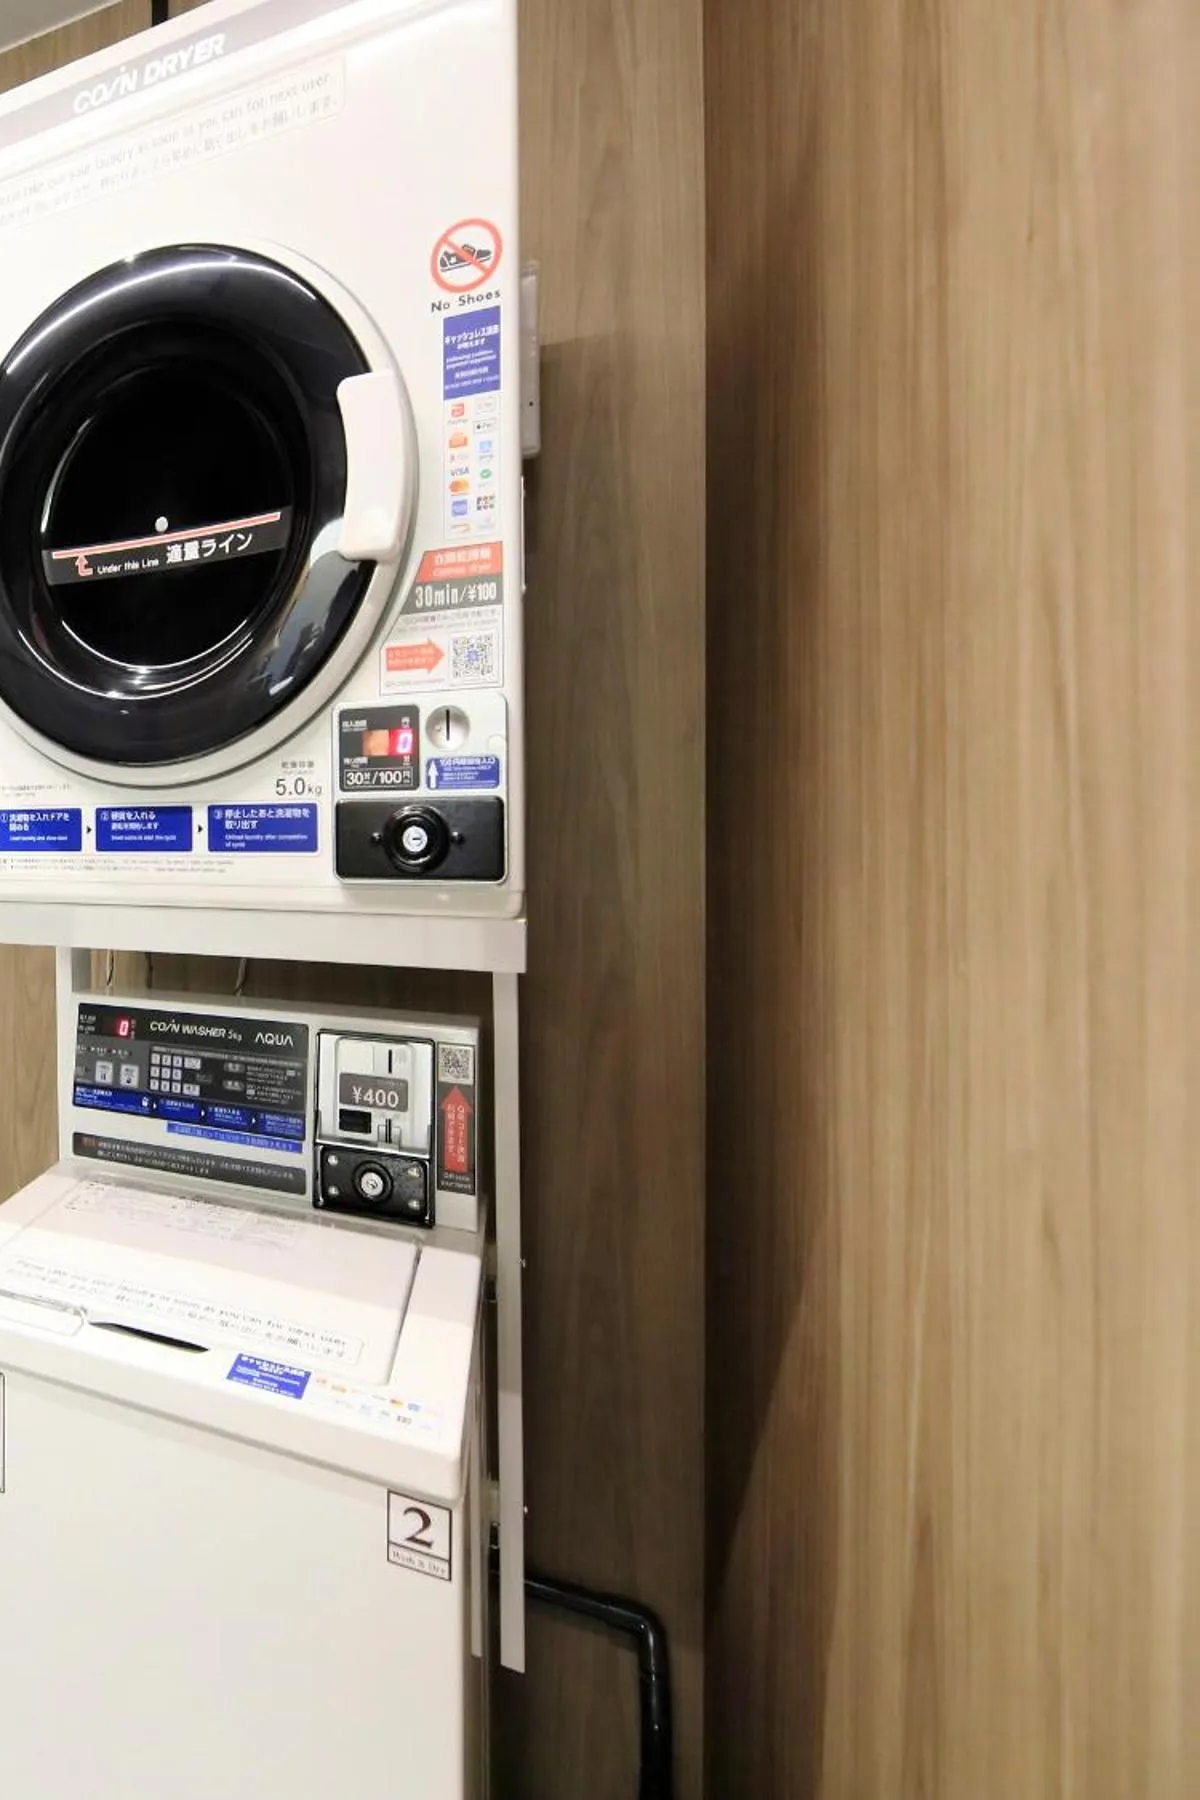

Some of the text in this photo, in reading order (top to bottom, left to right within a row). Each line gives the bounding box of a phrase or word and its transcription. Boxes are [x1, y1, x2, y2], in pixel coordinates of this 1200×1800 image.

[143, 33, 225, 86] DRYER
[431, 290, 501, 313] No Shoes
[166, 533, 253, 564] 適量ライン
[97, 565, 122, 574] Under
[119, 1020, 129, 1037] 0
[181, 1024, 227, 1039] WASHER
[254, 1031, 295, 1047] AQUA
[352, 1085, 400, 1108] ¥400
[402, 1506, 434, 1549] 2
